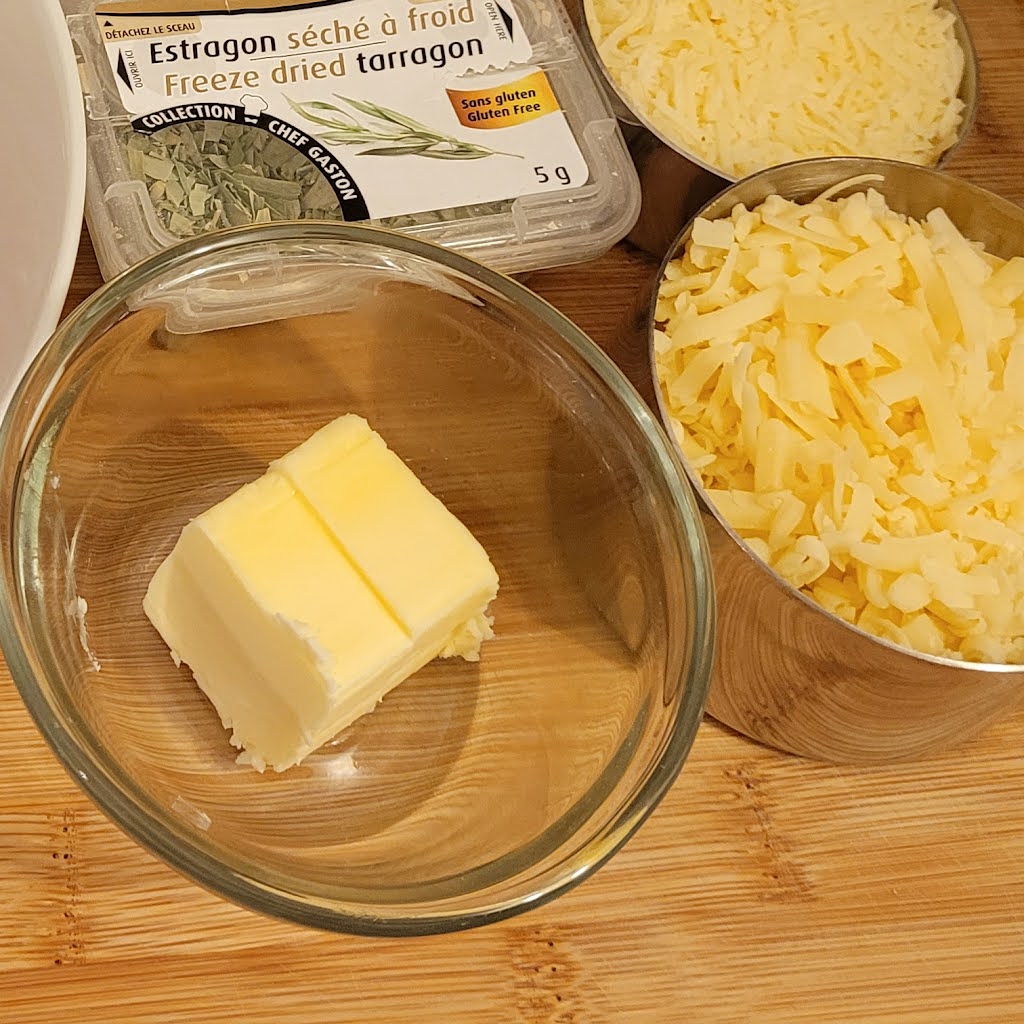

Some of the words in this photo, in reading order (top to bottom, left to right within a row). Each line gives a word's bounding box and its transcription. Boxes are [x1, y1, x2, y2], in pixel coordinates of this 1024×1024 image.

[104, 27, 151, 40] DÉTACHEZ
[153, 25, 164, 34] LE
[166, 22, 196, 33] SCEAU
[149, 34, 276, 64] Estragon
[287, 15, 370, 50] séché
[381, 13, 398, 36] à
[408, 0, 475, 32] froid
[484, 2, 499, 21] OPEN
[493, 22, 508, 41] HERE
[164, 69, 260, 97] Freeze
[271, 53, 346, 85] dried
[356, 37, 484, 74] tarragon
[461, 97, 492, 110] Sans
[495, 89, 536, 107] gluten
[467, 106, 510, 122] Gluten
[513, 102, 542, 115] Free
[142, 104, 236, 129] COLLECTION
[268, 120, 310, 147] CHEF
[308, 146, 358, 201] GASTON
[533, 166, 550, 183] 5
[554, 165, 572, 185] g
